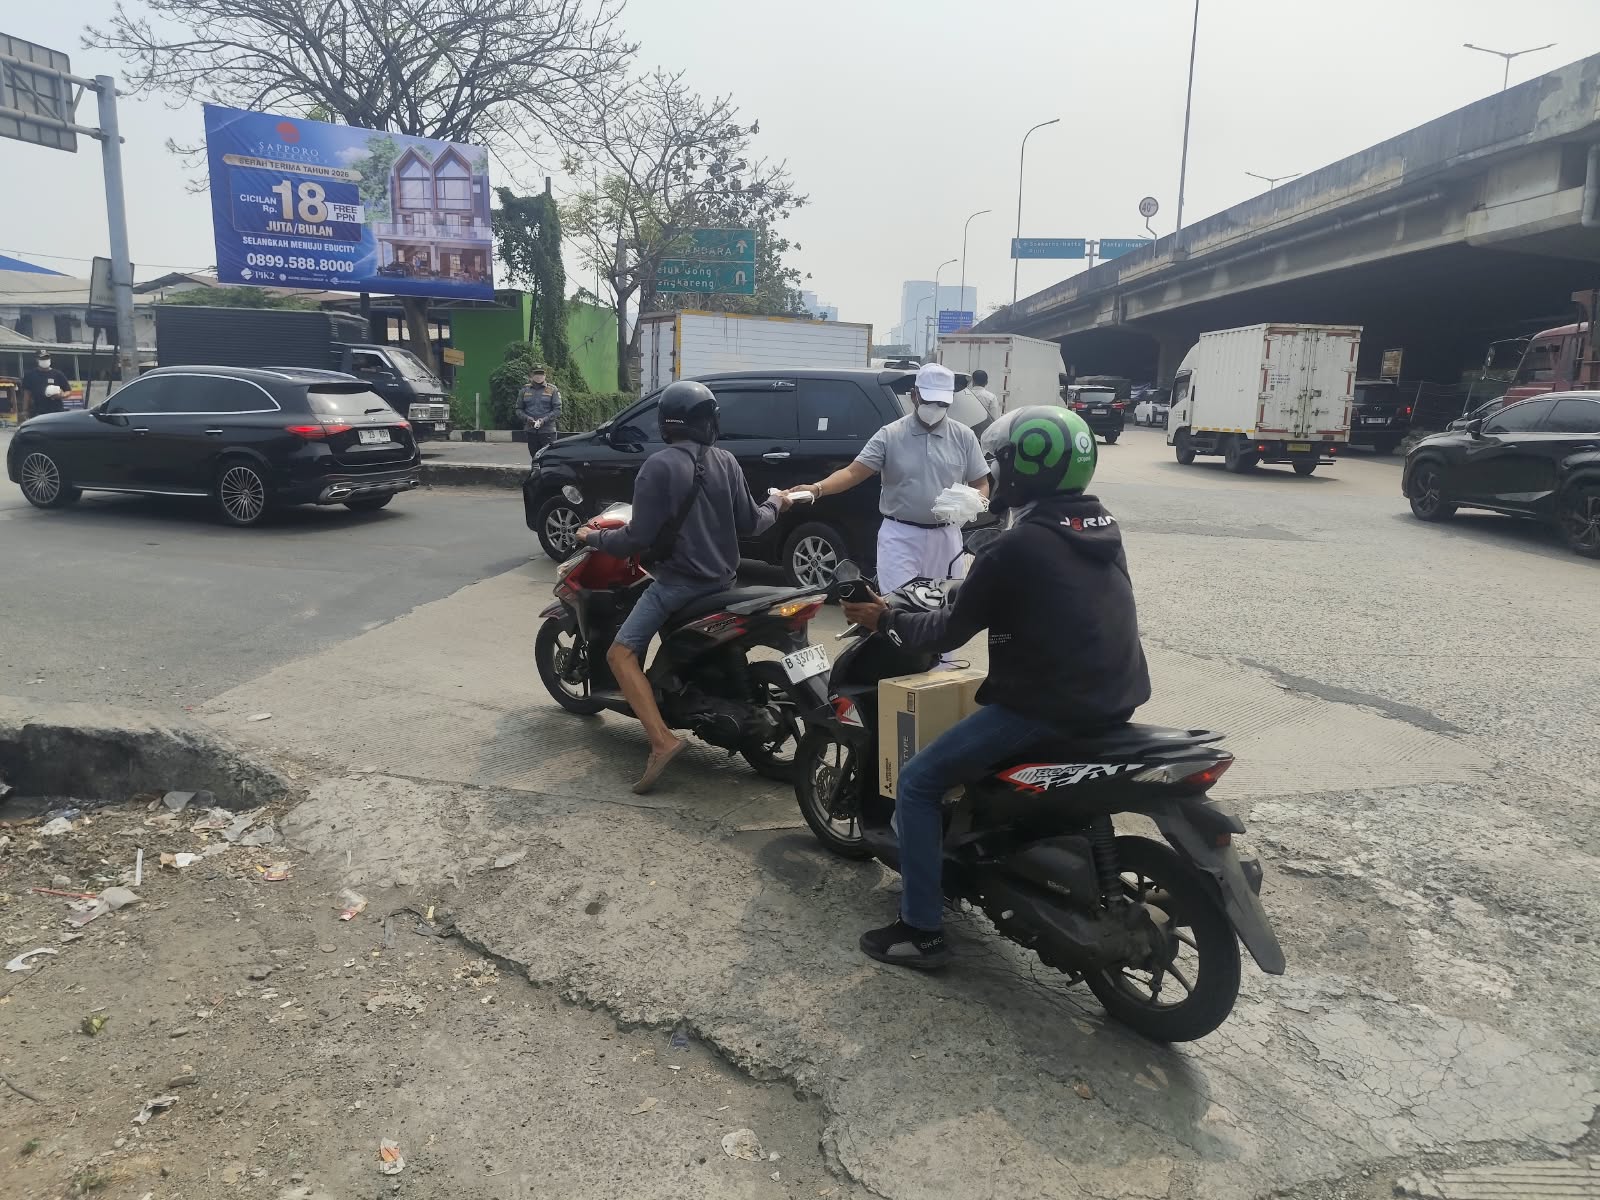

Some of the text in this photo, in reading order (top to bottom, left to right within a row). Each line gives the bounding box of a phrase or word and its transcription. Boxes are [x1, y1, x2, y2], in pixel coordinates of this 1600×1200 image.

[259, 142, 319, 157] SAPPORO
[239, 158, 349, 178] SERAH TERIMA TAHUN 2026
[240, 194, 277, 205] CICILAN
[272, 179, 329, 223] 18
[262, 204, 278, 214] Rp.
[333, 204, 358, 214] FREE
[336, 212, 356, 222] PPN
[266, 220, 333, 237] JUTA/BULAN
[242, 236, 355, 254] SELANGKAH MENUJU EDUCITY
[246, 252, 354, 273] 0899.588.8000
[255, 271, 275, 280] PIK2
[657, 266, 680, 274] eluk
[658, 278, 714, 289] engkareng
[785, 658, 794, 669] B
